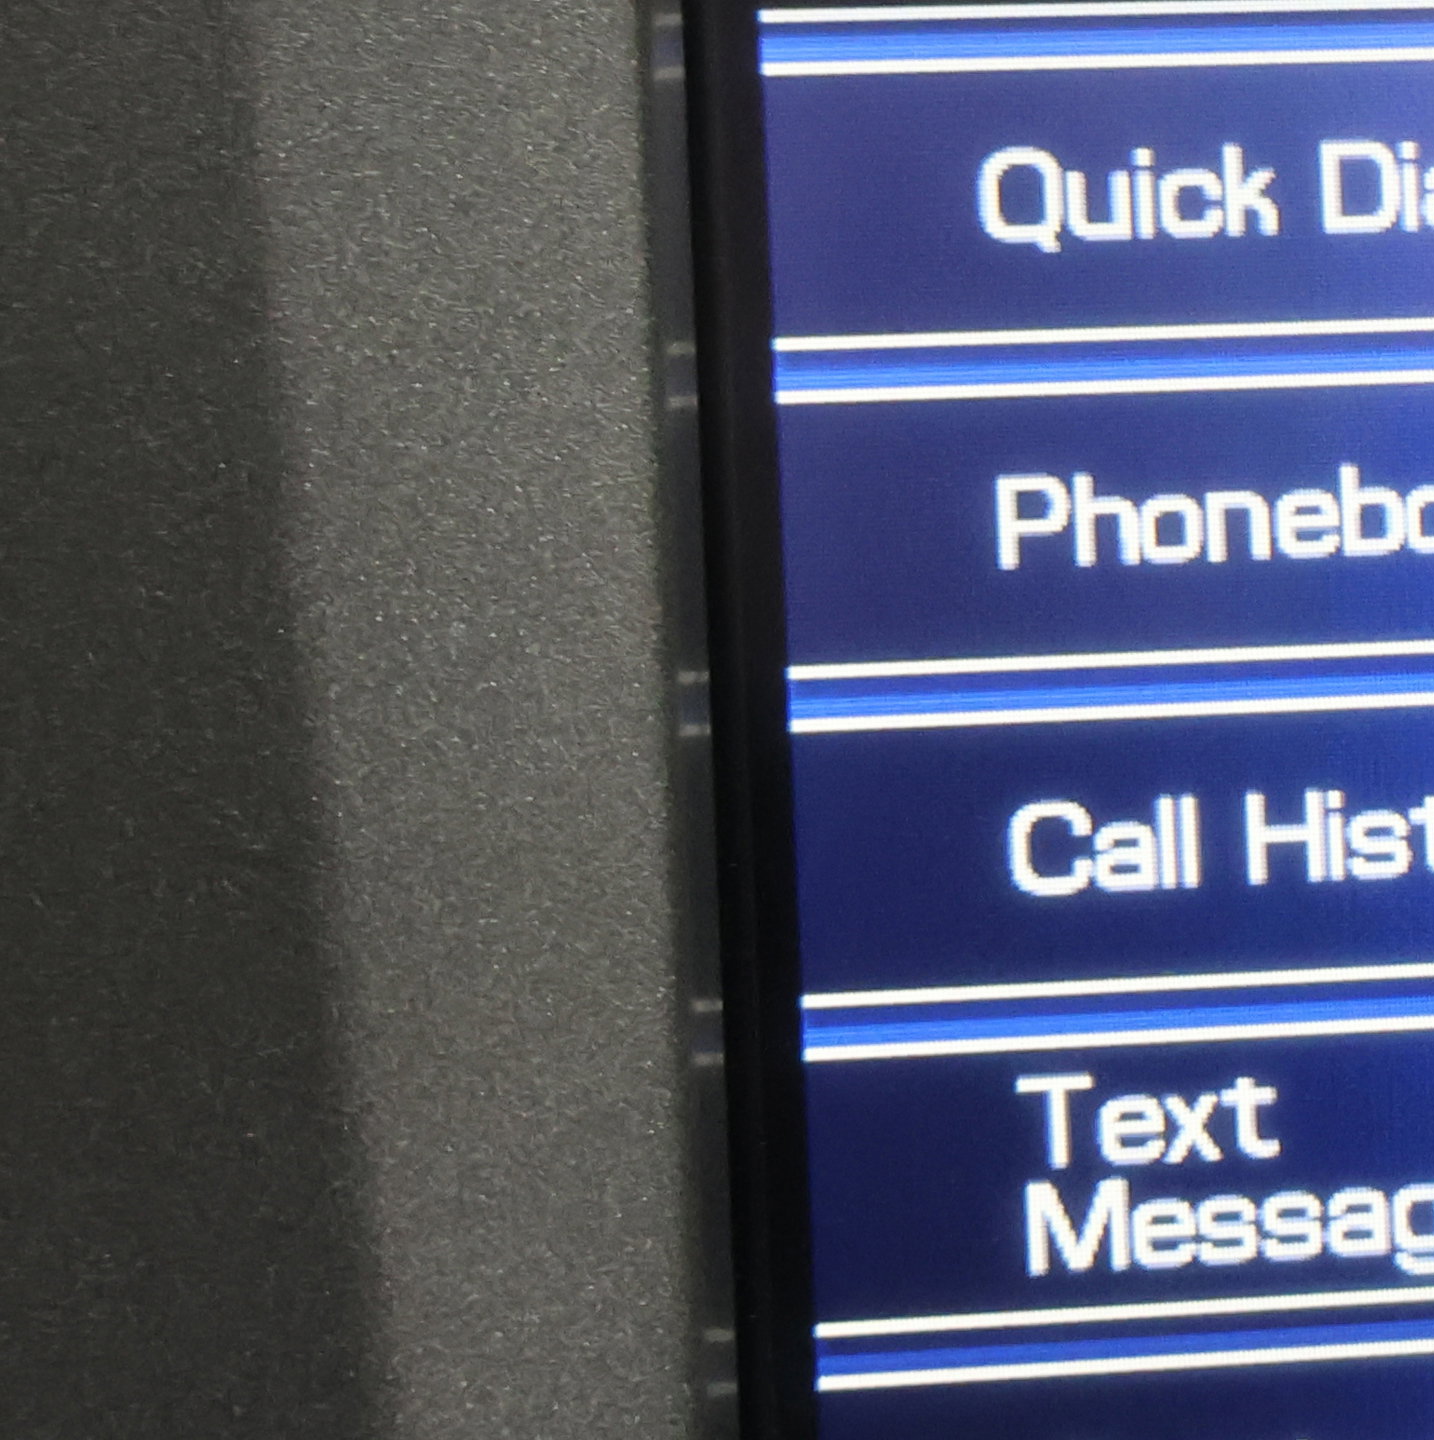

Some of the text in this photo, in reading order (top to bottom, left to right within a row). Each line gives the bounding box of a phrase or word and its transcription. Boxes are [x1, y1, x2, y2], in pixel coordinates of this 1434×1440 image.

[977, 143, 1279, 251] Quick
[1009, 795, 1199, 895] Call
[1016, 1073, 1279, 1168] Text
